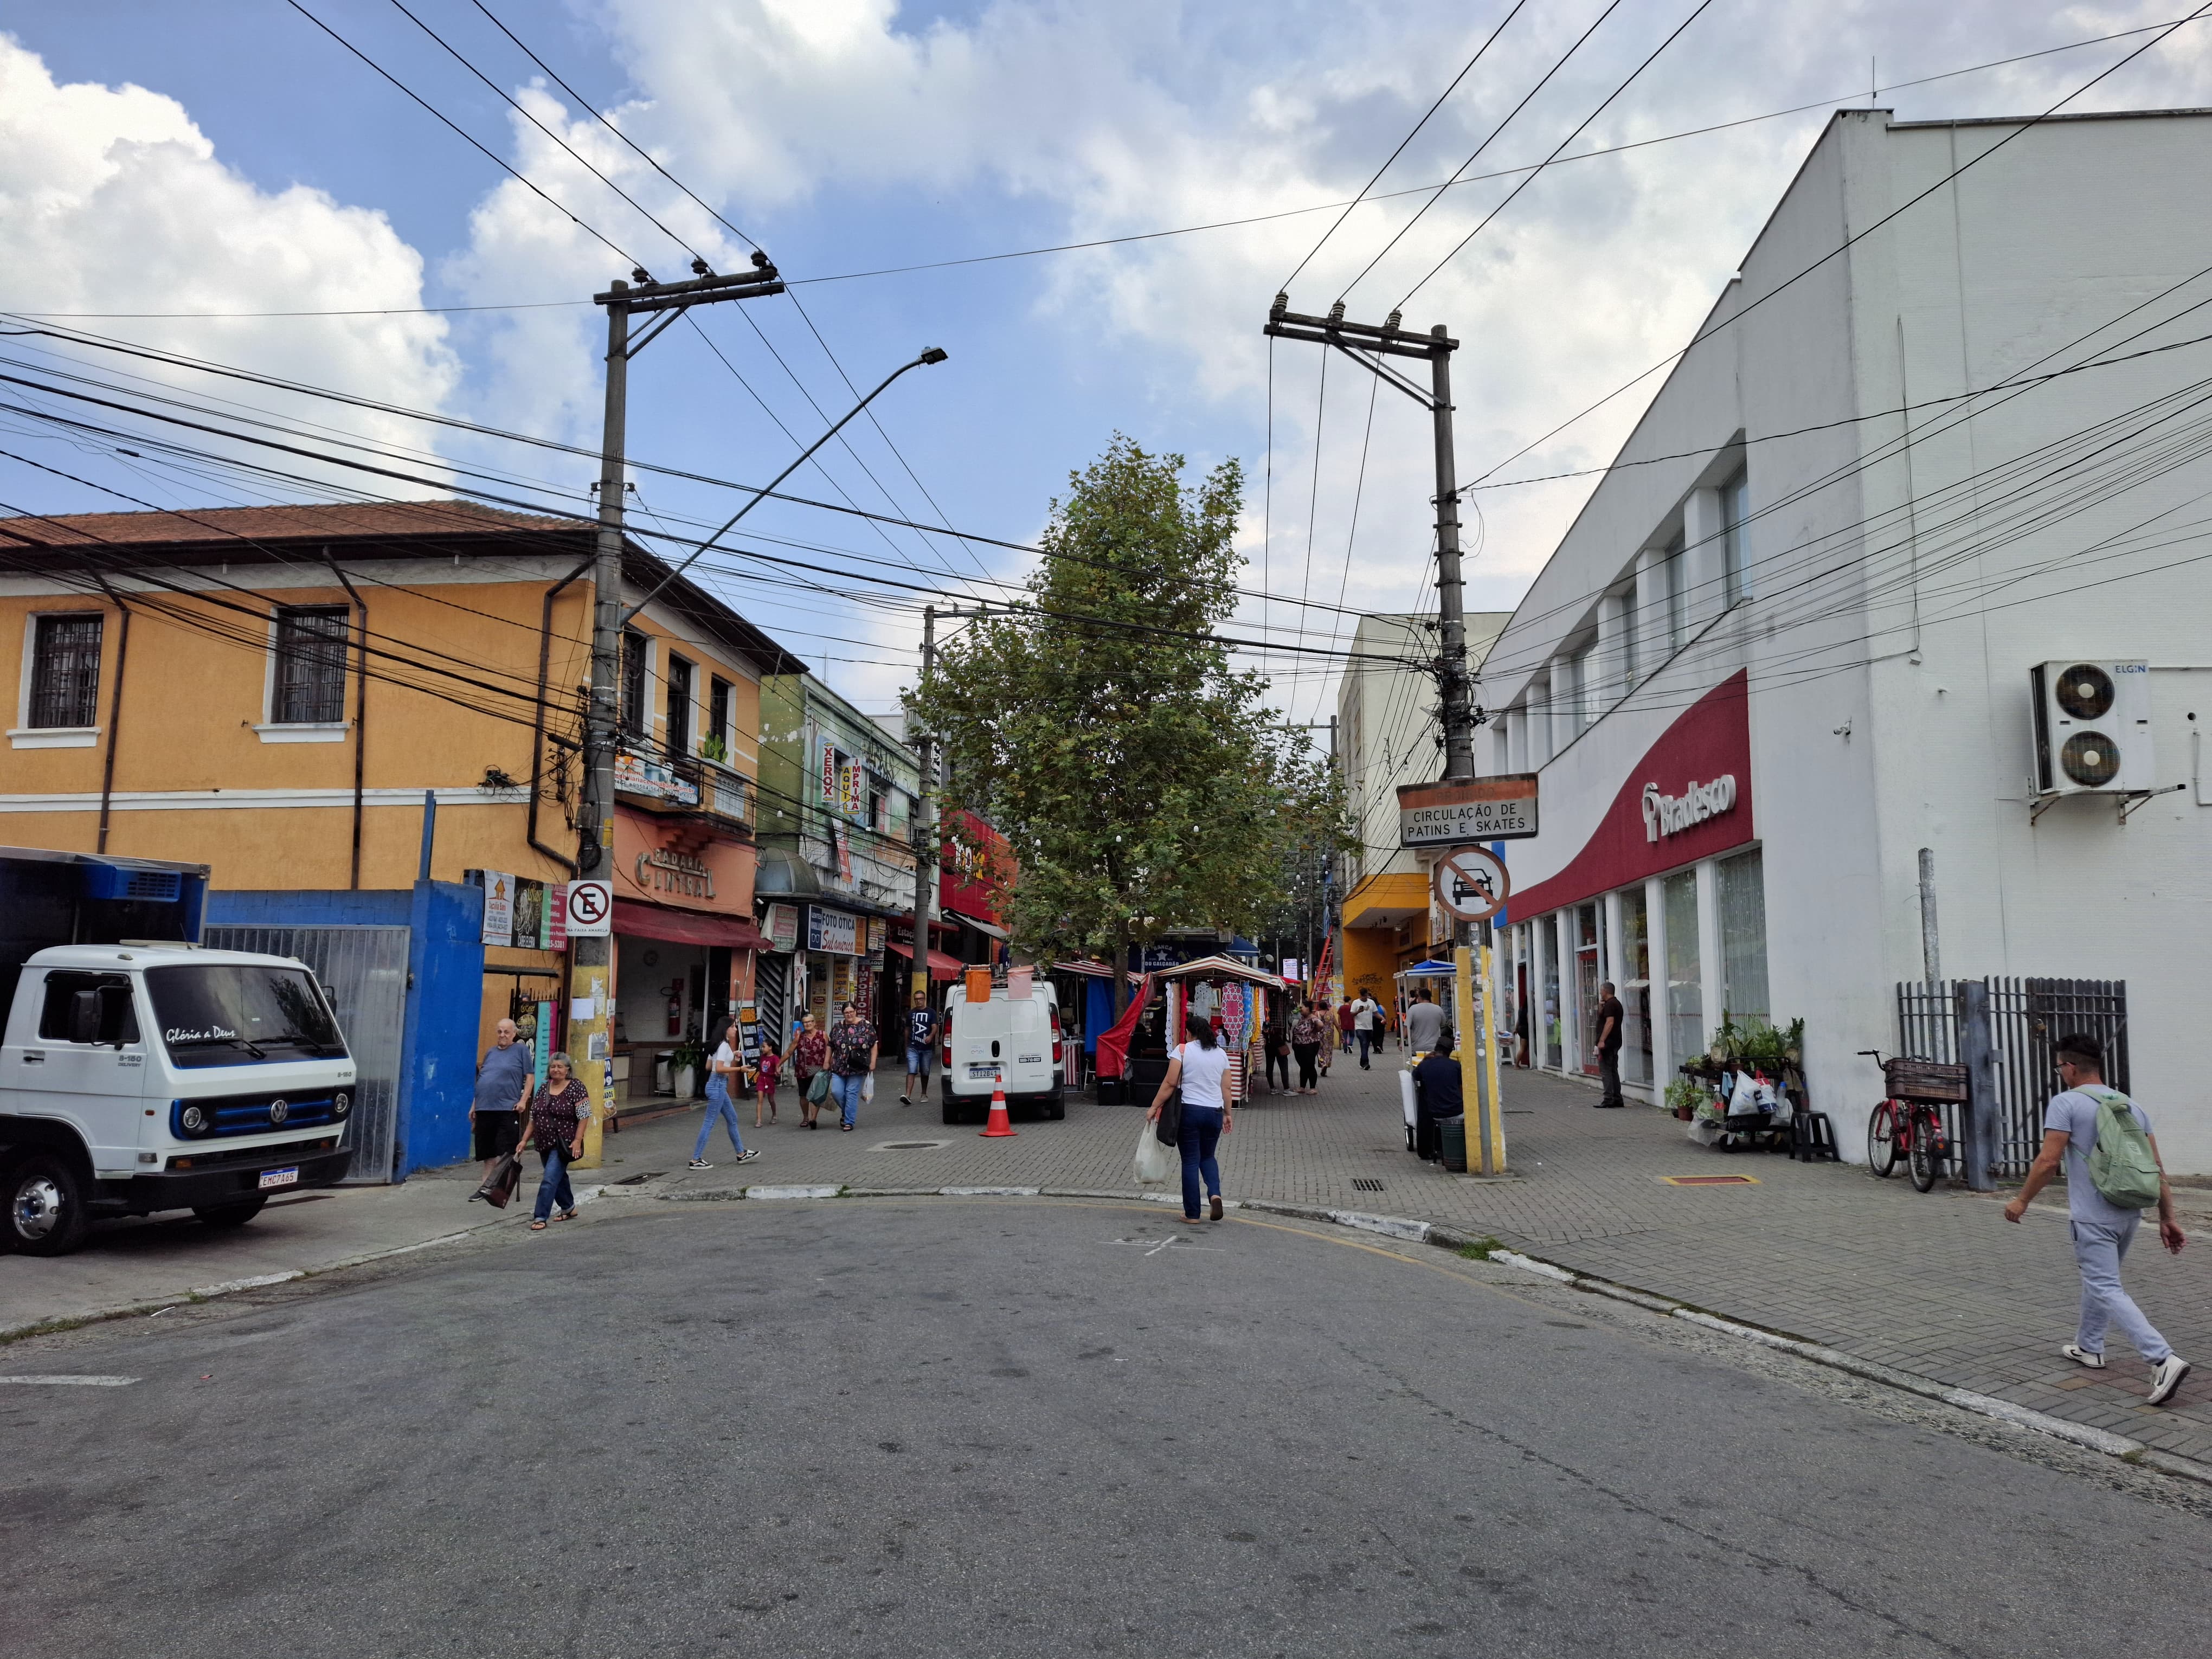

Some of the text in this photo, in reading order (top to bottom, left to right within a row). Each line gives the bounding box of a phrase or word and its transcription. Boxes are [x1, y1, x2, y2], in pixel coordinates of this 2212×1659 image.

[2115, 665, 2146, 673] ELGIN
[823, 748, 833, 796] XEROX
[851, 758, 861, 810] IMPRIMA
[1413, 803, 1516, 822] CIRCULAÇÃO DE
[1660, 774, 1736, 837] Bradesco
[1408, 817, 1525, 838] PATINS E SKATES
[655, 848, 704, 872] PADARIA
[635, 852, 716, 898] CENTRAL
[822, 912, 855, 931] FOTO ÓTICA
[858, 965, 869, 1008] IMPOSTO
[166, 1027, 201, 1044] Glória
[213, 1025, 236, 1038] Deus
[603, 1091, 613, 1099] ADOS
[262, 1172, 294, 1186] EMC7A65
